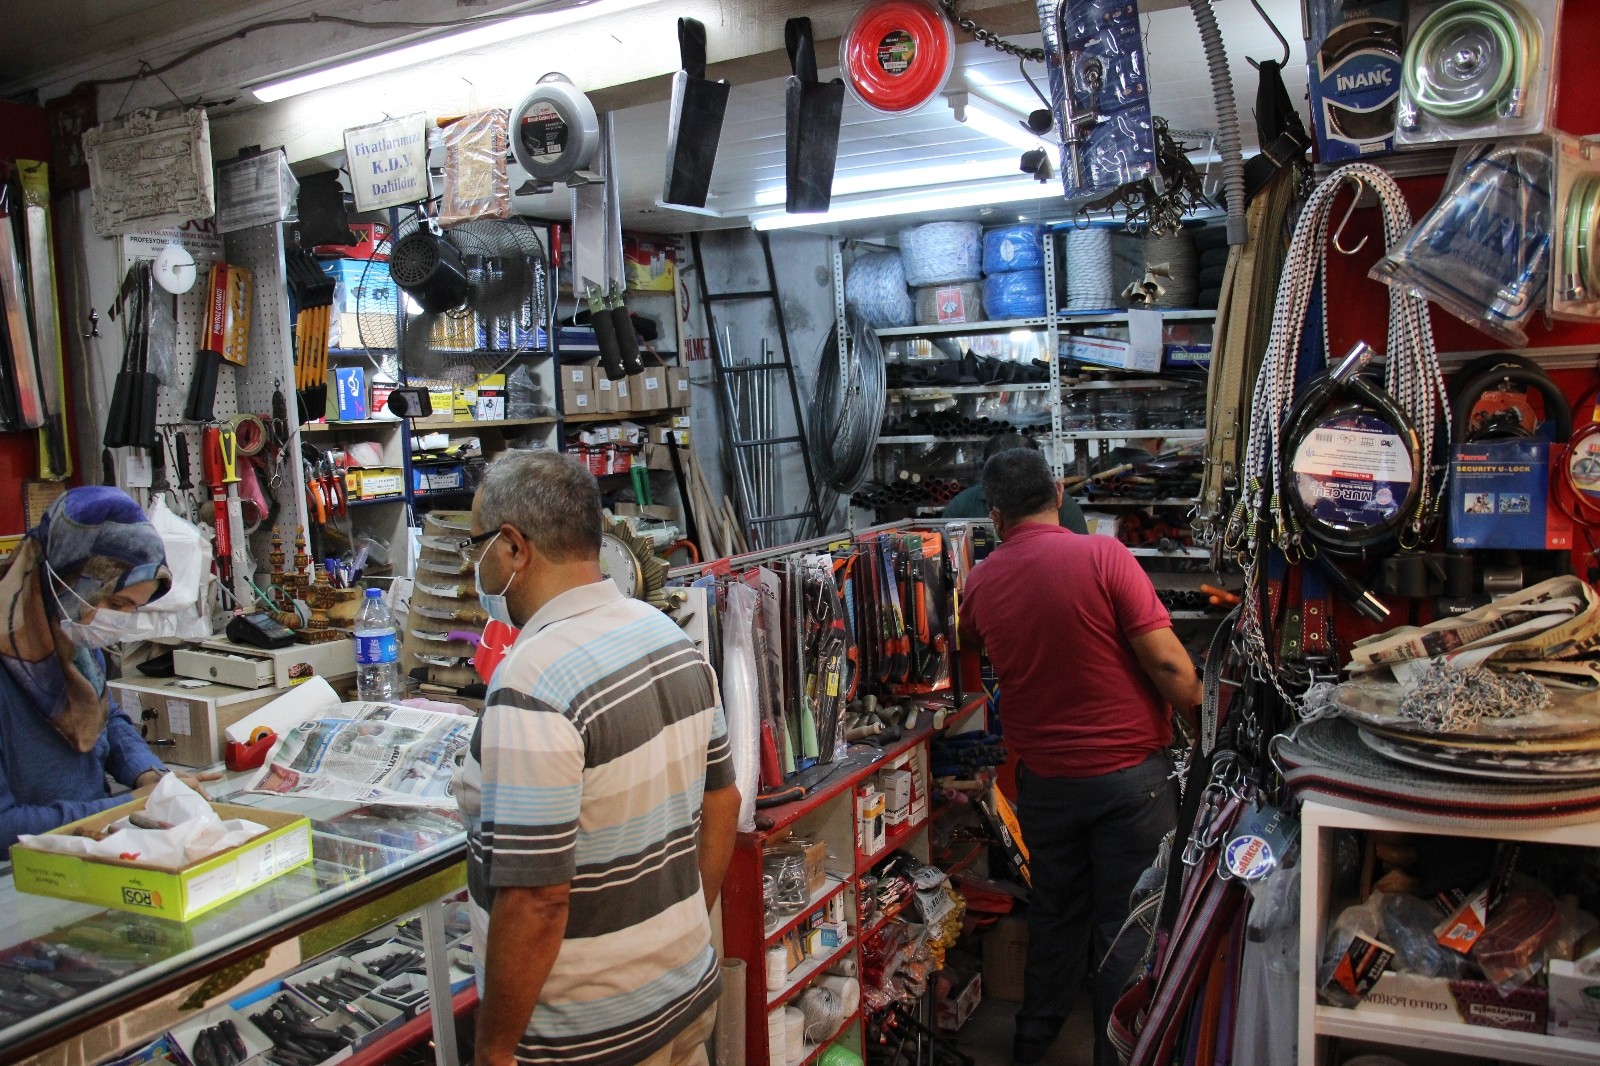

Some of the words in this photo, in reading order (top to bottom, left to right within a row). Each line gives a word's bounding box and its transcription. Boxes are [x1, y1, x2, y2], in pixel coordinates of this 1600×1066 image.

[1343, 8, 1371, 20] İNANÇ
[1336, 67, 1393, 92] İNANÇ
[354, 132, 421, 158] Fiyatlarımıza
[372, 175, 417, 196] Dahildir.
[1309, 486, 1373, 502] MUR-CELL
[125, 889, 153, 906] ROS
